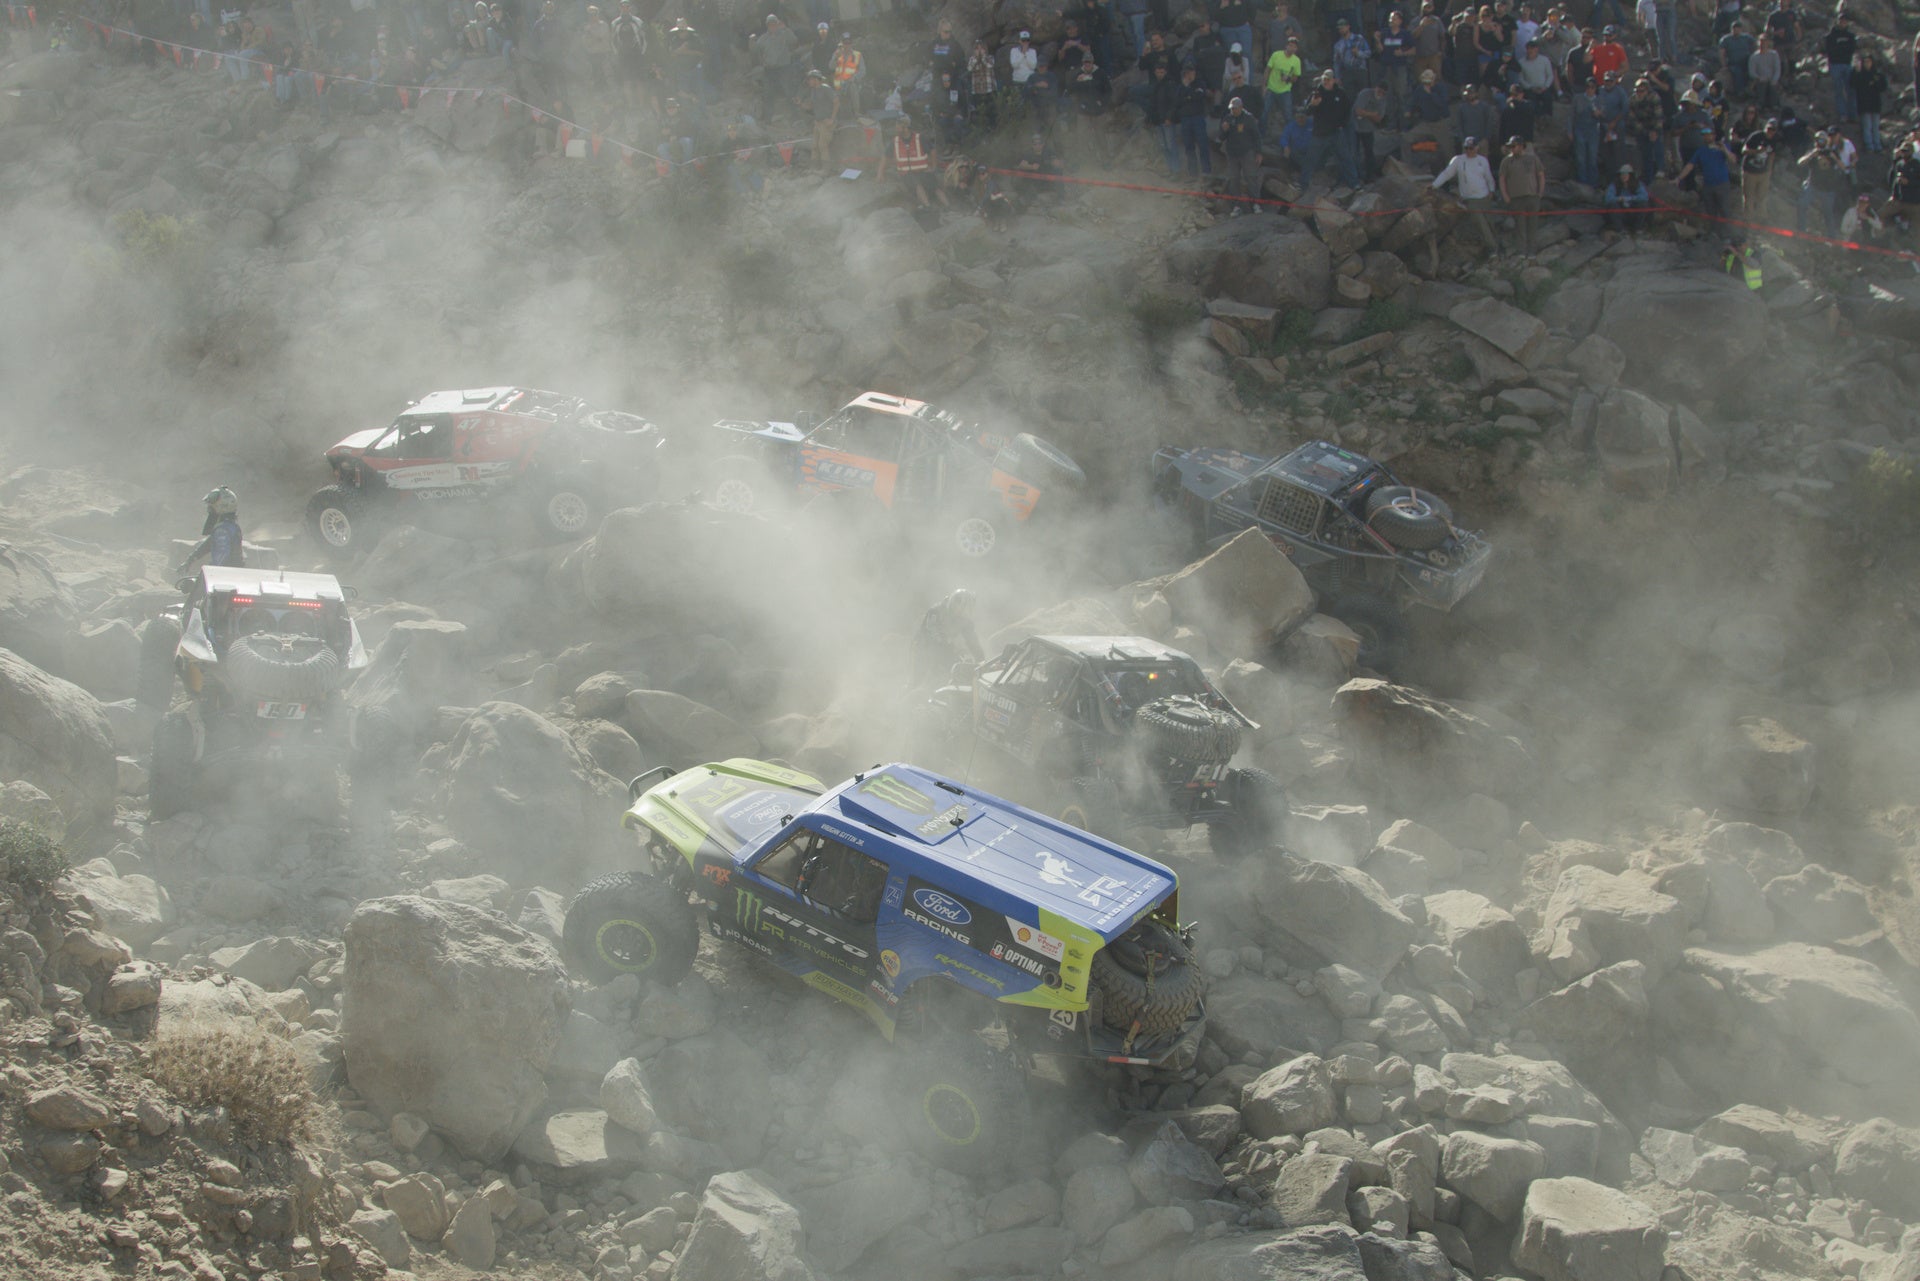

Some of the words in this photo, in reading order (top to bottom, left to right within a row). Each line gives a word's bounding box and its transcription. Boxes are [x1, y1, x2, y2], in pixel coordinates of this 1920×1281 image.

[457, 418, 481, 431] 47
[415, 487, 476, 501] YOKOHAMA
[703, 863, 732, 882] FOX
[923, 893, 962, 921] Ford
[762, 905, 870, 960] NITTO
[903, 907, 971, 945] RACING
[725, 929, 740, 939] NO
[742, 936, 773, 955] ROADS
[812, 946, 866, 977] VEHICLES
[934, 953, 1005, 990] RAPTOR
[1004, 948, 1044, 976] OPTIMA
